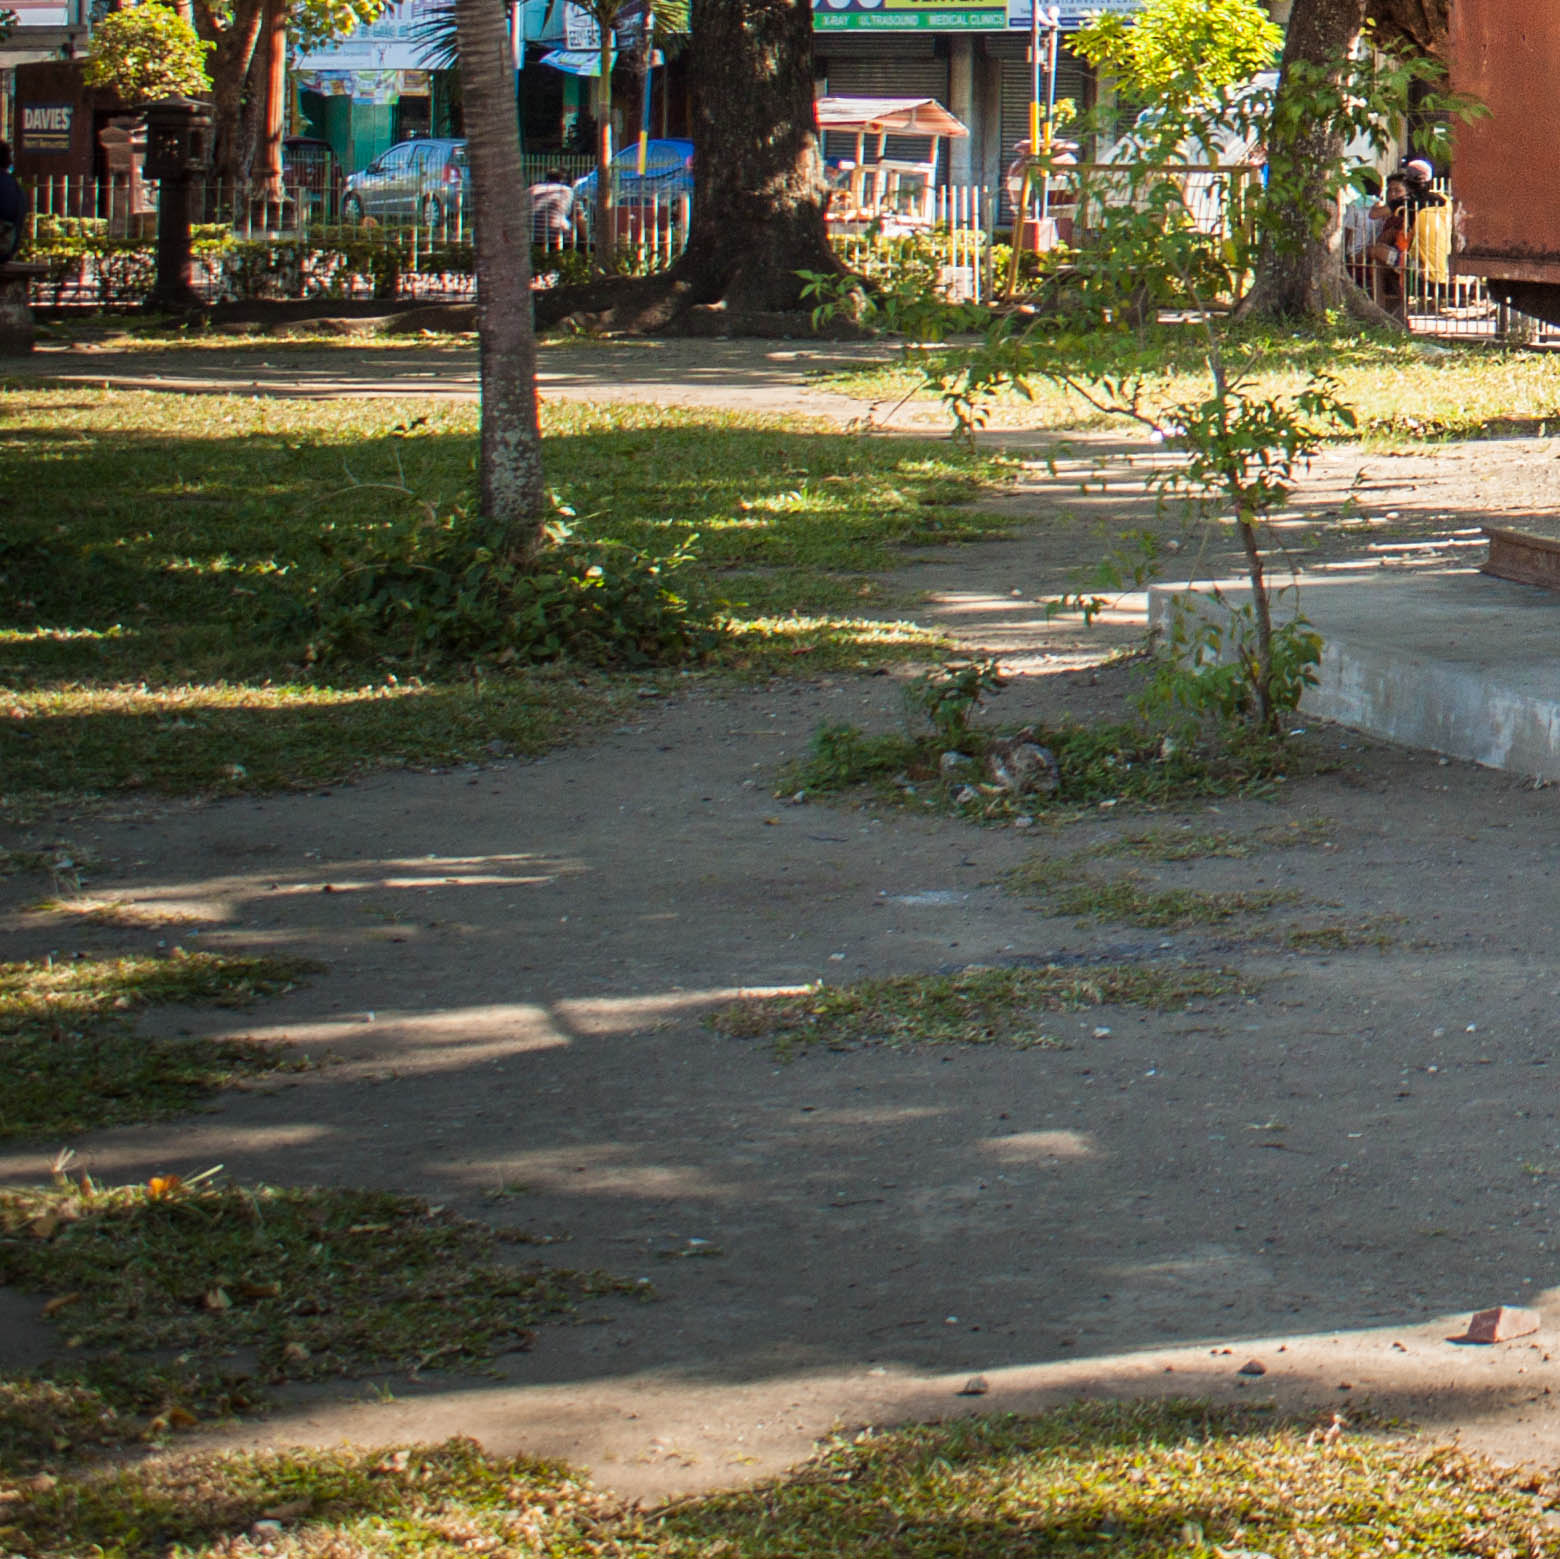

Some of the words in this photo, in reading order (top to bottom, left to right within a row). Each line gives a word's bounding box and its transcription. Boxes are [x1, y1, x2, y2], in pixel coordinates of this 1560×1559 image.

[822, 15, 849, 26] X-RAY
[858, 15, 920, 26] ULTRASOUND
[928, 14, 967, 26] MEDICAL
[969, 14, 1005, 26] CLINICS
[23, 107, 72, 130] DAVIES
